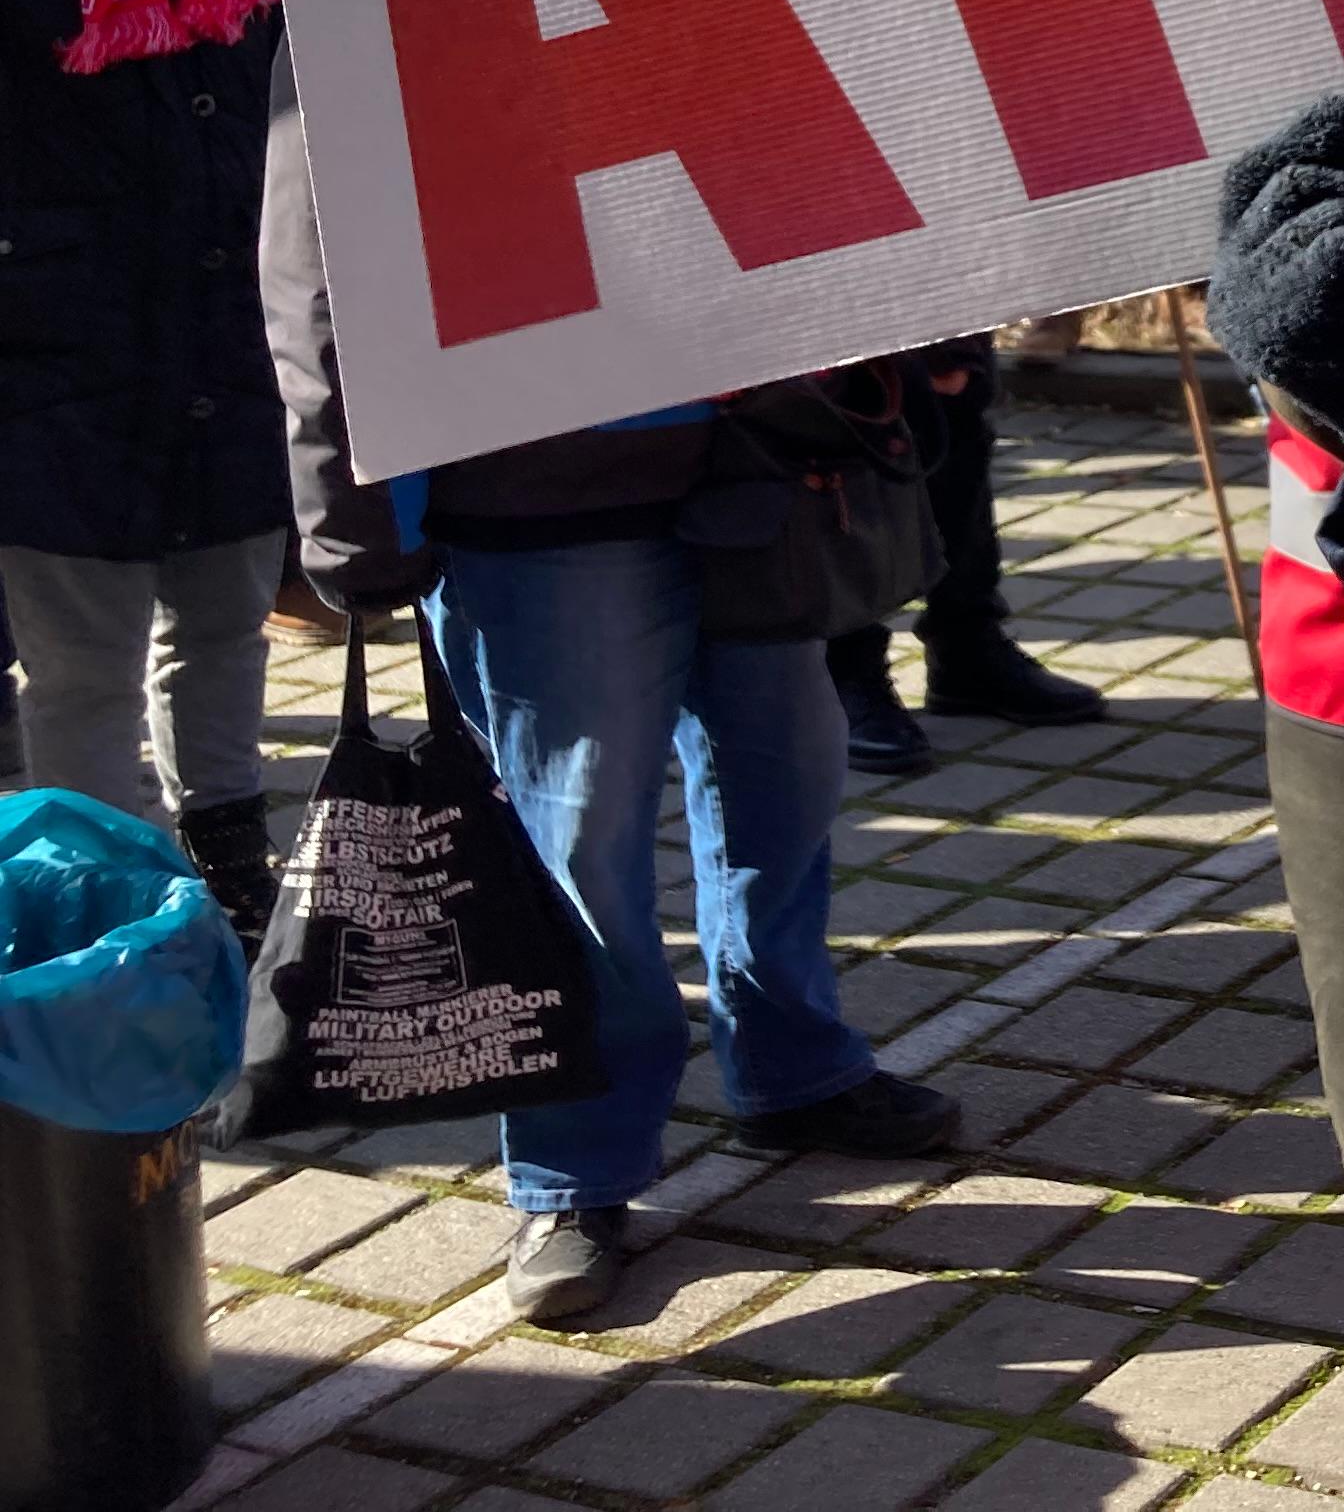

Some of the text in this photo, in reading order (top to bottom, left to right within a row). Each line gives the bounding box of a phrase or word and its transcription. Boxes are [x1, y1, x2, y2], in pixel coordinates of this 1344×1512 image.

[351, 904, 445, 929] SOFTAIR
[307, 1019, 429, 1041] MILITARY
[435, 989, 563, 1034] OUTDOOR
[318, 1007, 414, 1024] PAINTBALL
[313, 1043, 512, 1089] LUFTGEWEHRE
[360, 1051, 559, 1103] LUFTPISTOLEN
